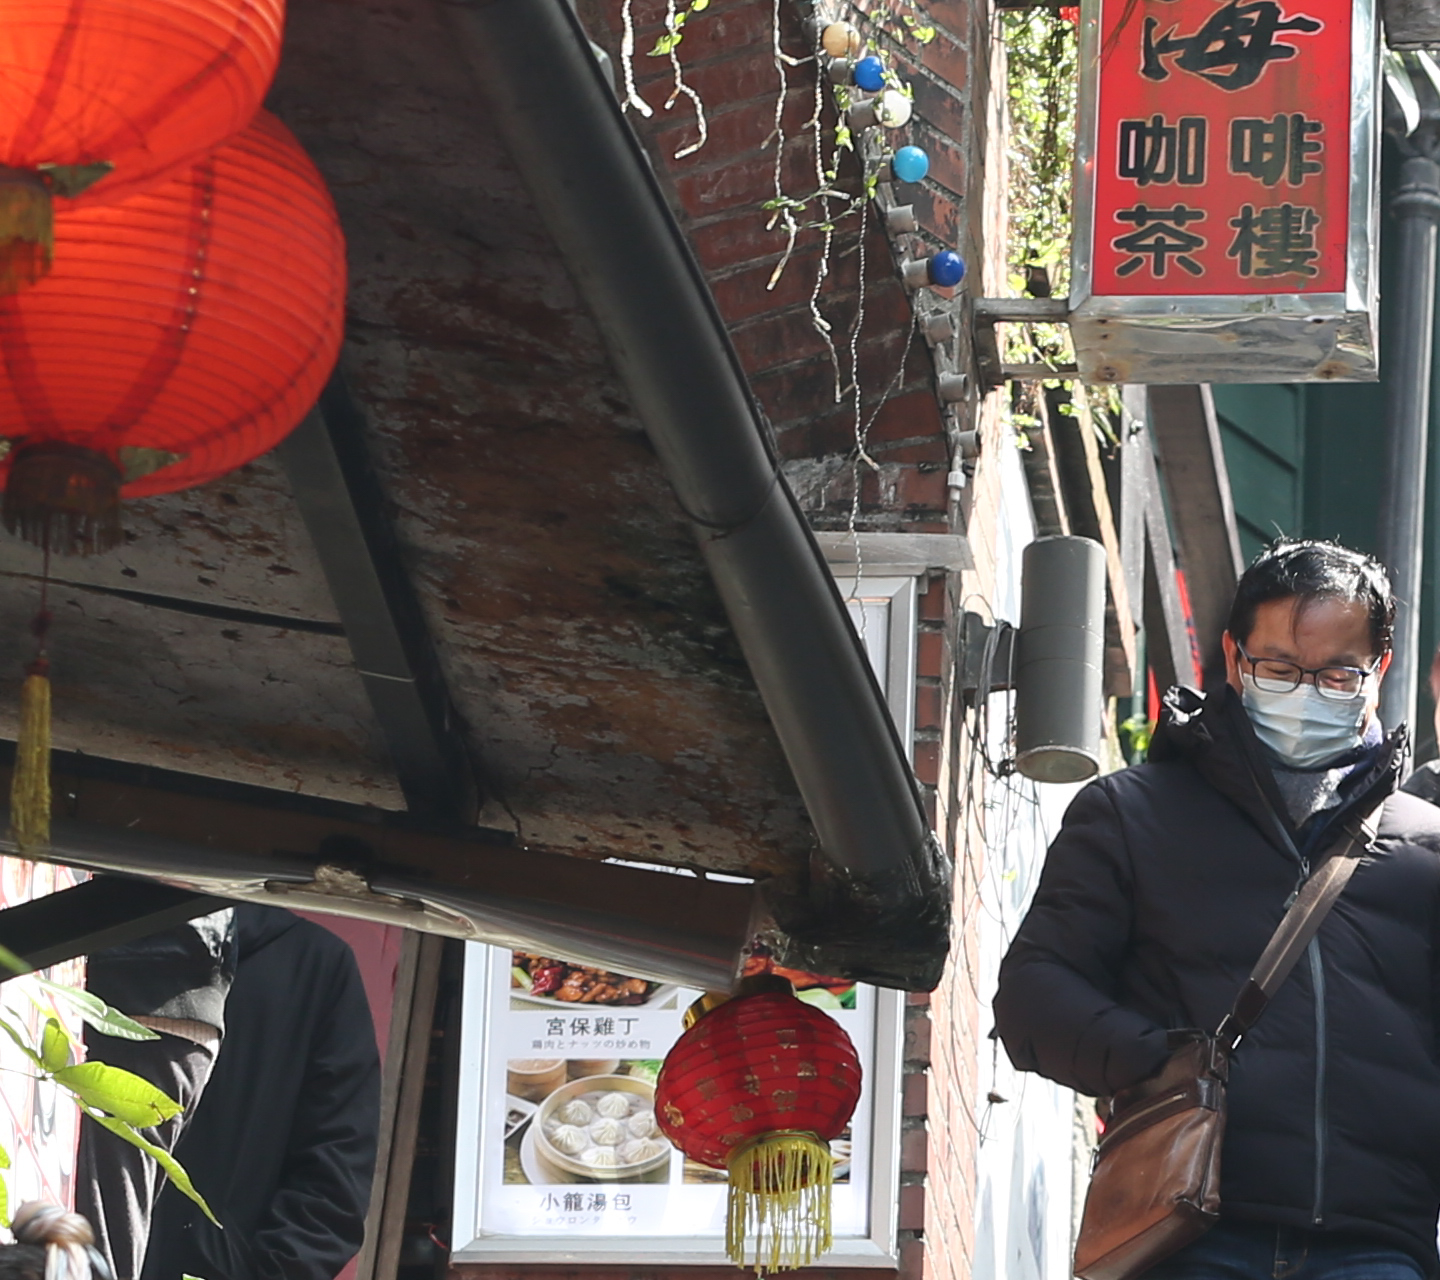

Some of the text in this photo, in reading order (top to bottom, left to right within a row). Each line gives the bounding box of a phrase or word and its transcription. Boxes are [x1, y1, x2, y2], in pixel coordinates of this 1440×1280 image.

[1117, 114, 1323, 187] 咖啡
[1112, 204, 1320, 279] 茶樓
[546, 1017, 640, 1037] 宮保雞丁
[539, 1192, 633, 1213] 小籠湯包
